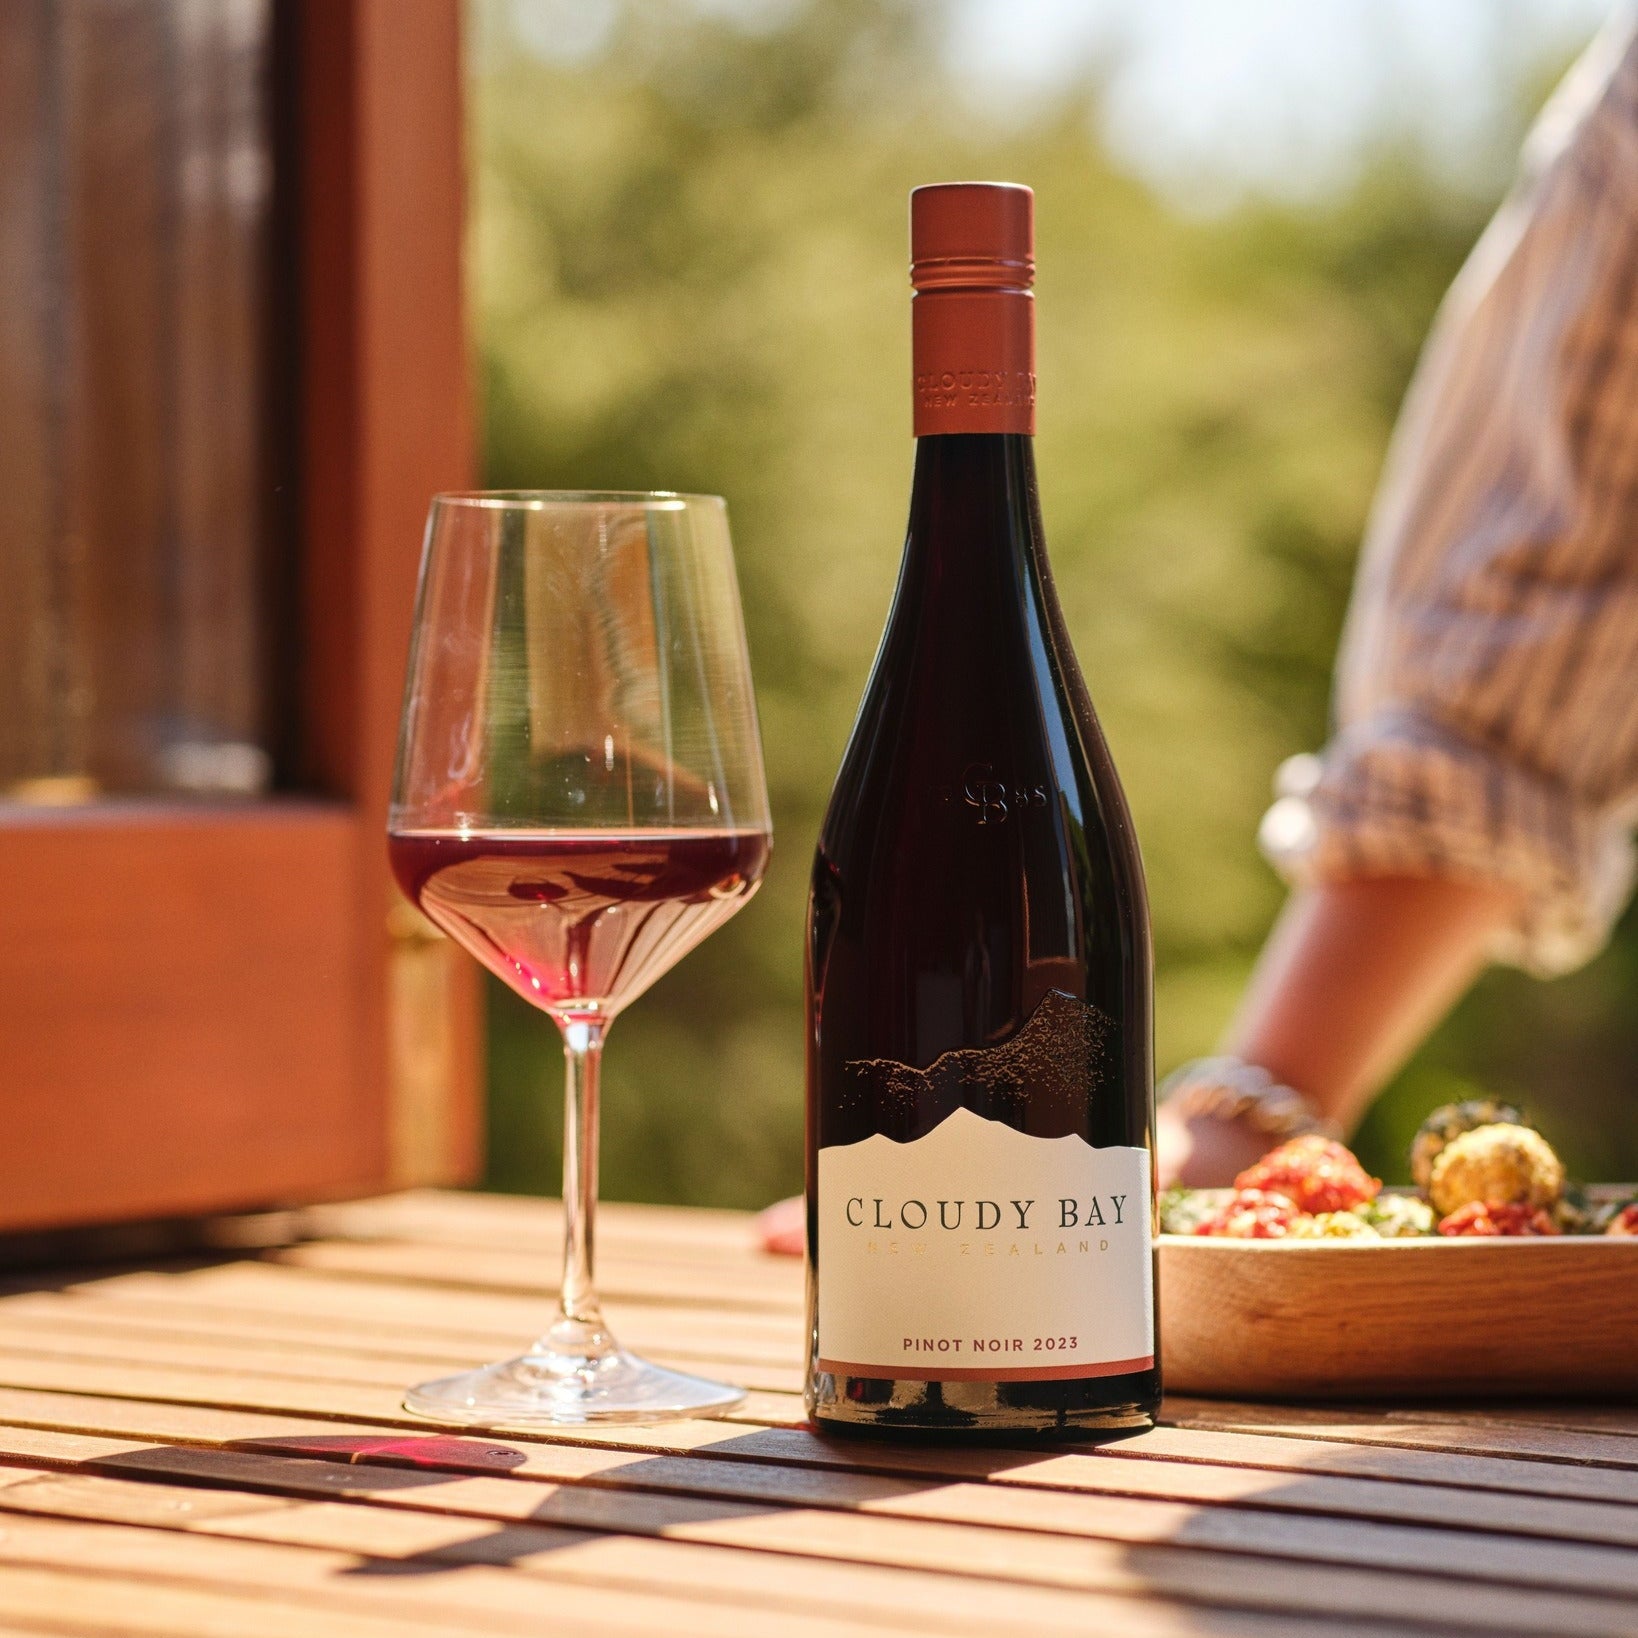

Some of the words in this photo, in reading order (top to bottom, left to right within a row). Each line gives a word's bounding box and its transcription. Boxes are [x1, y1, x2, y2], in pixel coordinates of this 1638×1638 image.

[846, 1196, 1035, 1230] CLOUDY
[1058, 1195, 1127, 1228] BAY
[867, 1241, 927, 1256] NEW
[959, 1239, 1109, 1256] ZEALAND
[902, 1337, 963, 1352] PINOT
[973, 1337, 1023, 1352] NOIR
[1033, 1336, 1079, 1352] 2023
